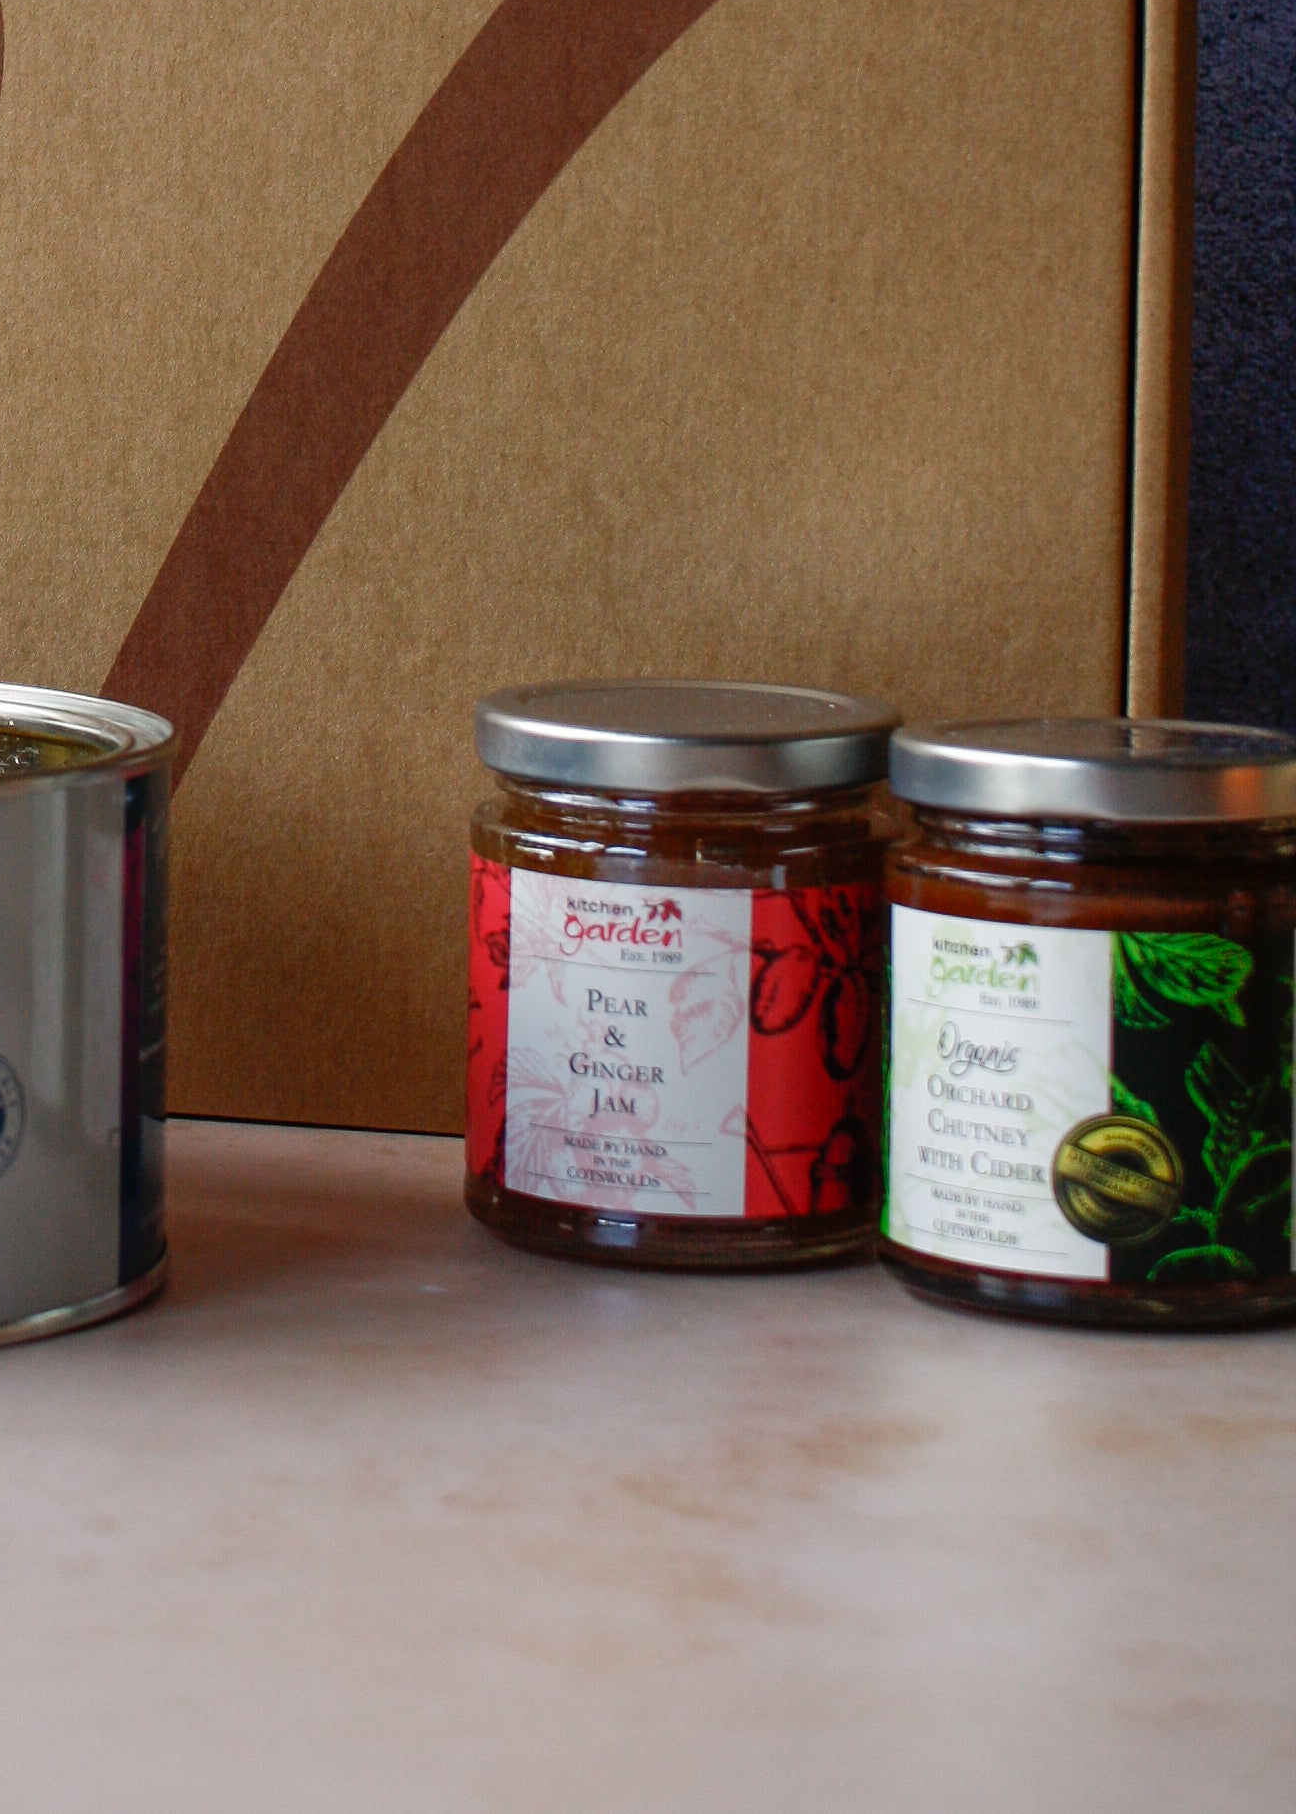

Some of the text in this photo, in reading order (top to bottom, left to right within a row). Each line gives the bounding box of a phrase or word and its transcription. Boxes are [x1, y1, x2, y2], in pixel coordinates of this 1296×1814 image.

[566, 897, 634, 916] kitchen
[559, 913, 683, 956] garden
[931, 937, 992, 958] kitchen
[926, 955, 1038, 998] garden
[604, 1025, 626, 1048] &
[937, 1021, 1021, 1076] Organic
